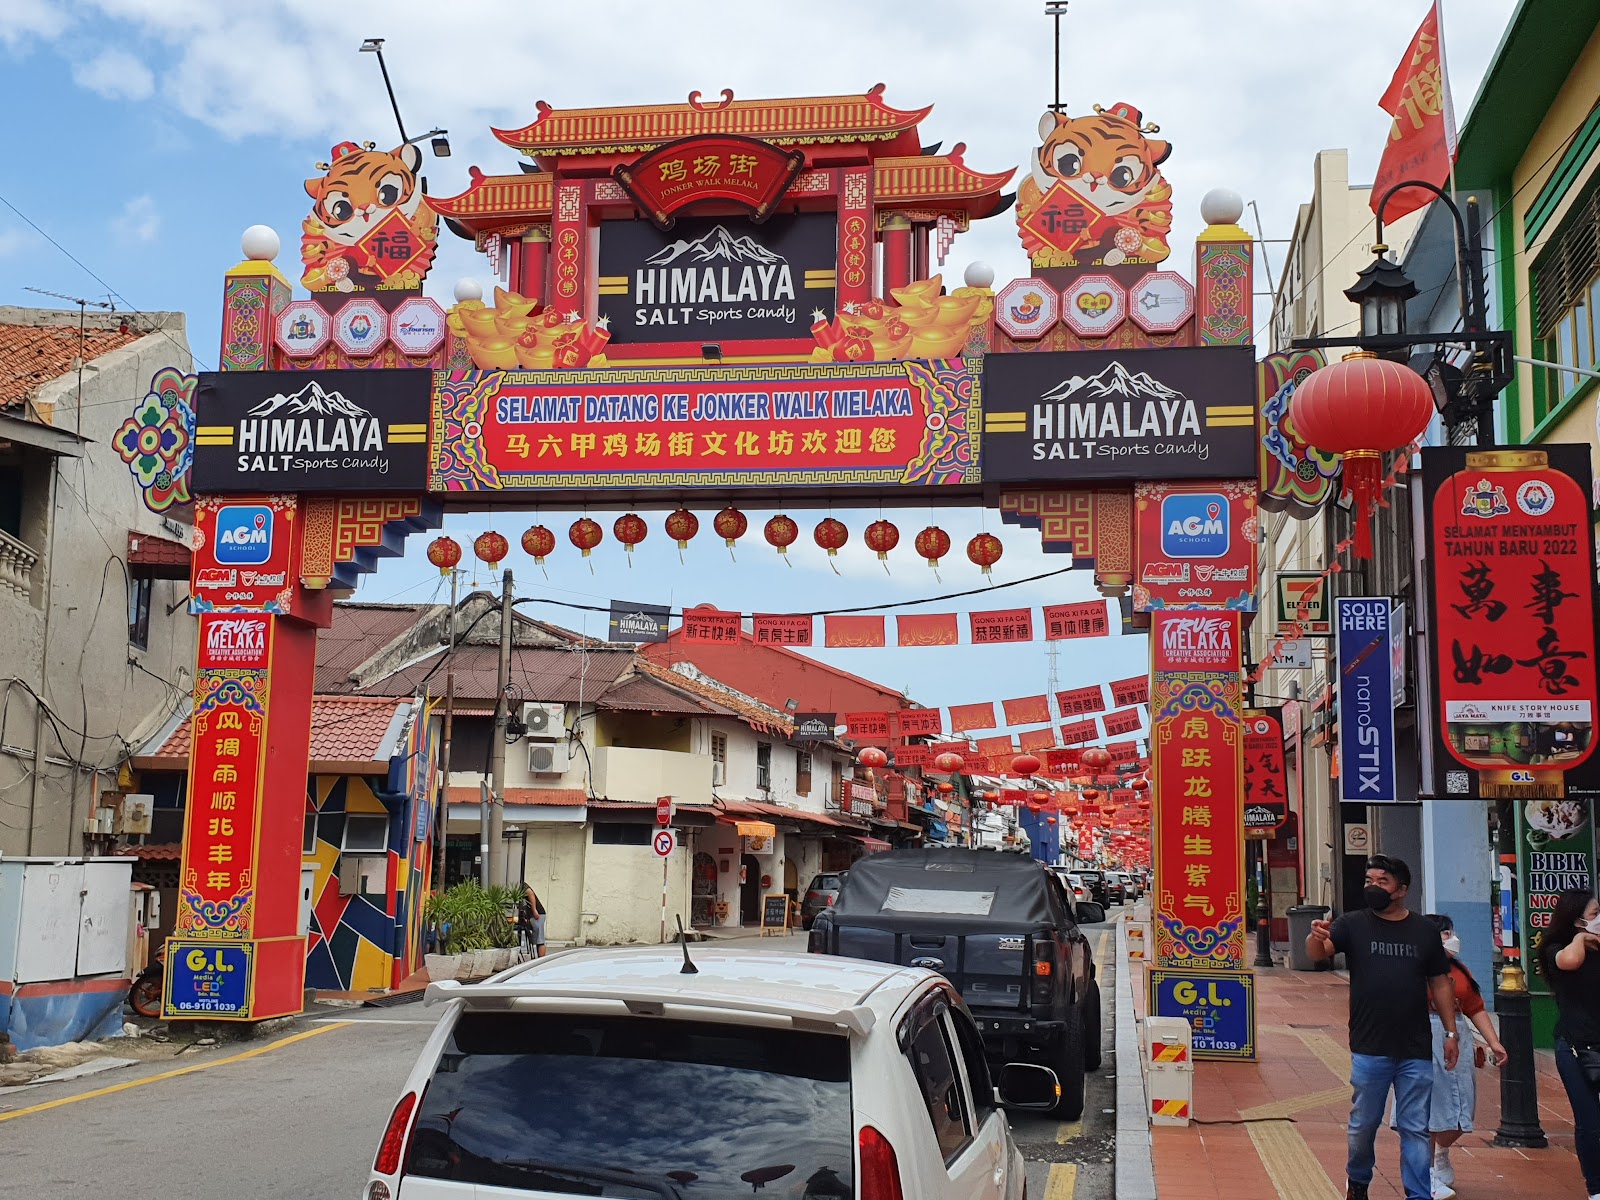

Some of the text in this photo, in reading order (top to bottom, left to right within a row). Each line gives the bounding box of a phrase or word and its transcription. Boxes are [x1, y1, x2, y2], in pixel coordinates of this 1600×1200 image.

[658, 153, 759, 182] 鸡场街
[660, 178, 759, 199] JONKER WALK MELAKA
[1041, 204, 1087, 234] 福
[371, 231, 411, 259] 福
[848, 220, 861, 283] 恭喜發財
[562, 232, 575, 293] 新年快樂
[635, 264, 796, 305] HIMALAYA
[635, 305, 796, 326] SALT Sports Candy
[496, 387, 913, 426] SELAMAT DATANG KE JONKER WALK MELAKA
[1032, 399, 1201, 440] HIMALAYA
[237, 417, 384, 453] HIMALAYA
[504, 427, 897, 459] 马六甲鸡场街文化坊欢迎您
[1033, 440, 1209, 461] SALT Sports Candy
[237, 454, 390, 474] SALT Sports Candy
[221, 526, 268, 544] AGM
[1168, 516, 1224, 536] AGM
[1444, 524, 1578, 538] SELAMAT MENYAMBUT
[1444, 540, 1578, 557] TAHUN BARU 2022
[199, 569, 231, 582] AGM
[1143, 563, 1183, 577] AGM
[686, 615, 707, 623] GONG
[1049, 611, 1070, 619] GONG
[1342, 602, 1386, 617] SOLD
[620, 620, 658, 632] HIMALAYA
[686, 623, 737, 641] 新年快樂
[975, 623, 1029, 641] 恭贺新禧
[1050, 617, 1105, 637] 身体健康
[1342, 616, 1387, 631] HERE
[207, 632, 265, 649] MELAKA
[1163, 631, 1232, 650] MELAKA
[1117, 689, 1149, 705] 萬事如
[850, 723, 887, 734] 新年快樂
[1357, 675, 1381, 793] nanoSTIX
[1511, 771, 1534, 781] G.L.
[205, 710, 244, 892] 风调雨顺兆丰年
[1180, 716, 1215, 918] 虎跃龙腾生紫气
[1530, 852, 1588, 872] BIBIK
[1530, 872, 1589, 892] HOUSE
[1529, 894, 1561, 909] NYO
[186, 949, 234, 972] G.L.
[194, 981, 220, 992] LED
[1173, 981, 1231, 1007] G.L.
[180, 1002, 236, 1011] 06-910 1039
[1192, 1017, 1215, 1028] ED
[1210, 1041, 1237, 1050] 1039
